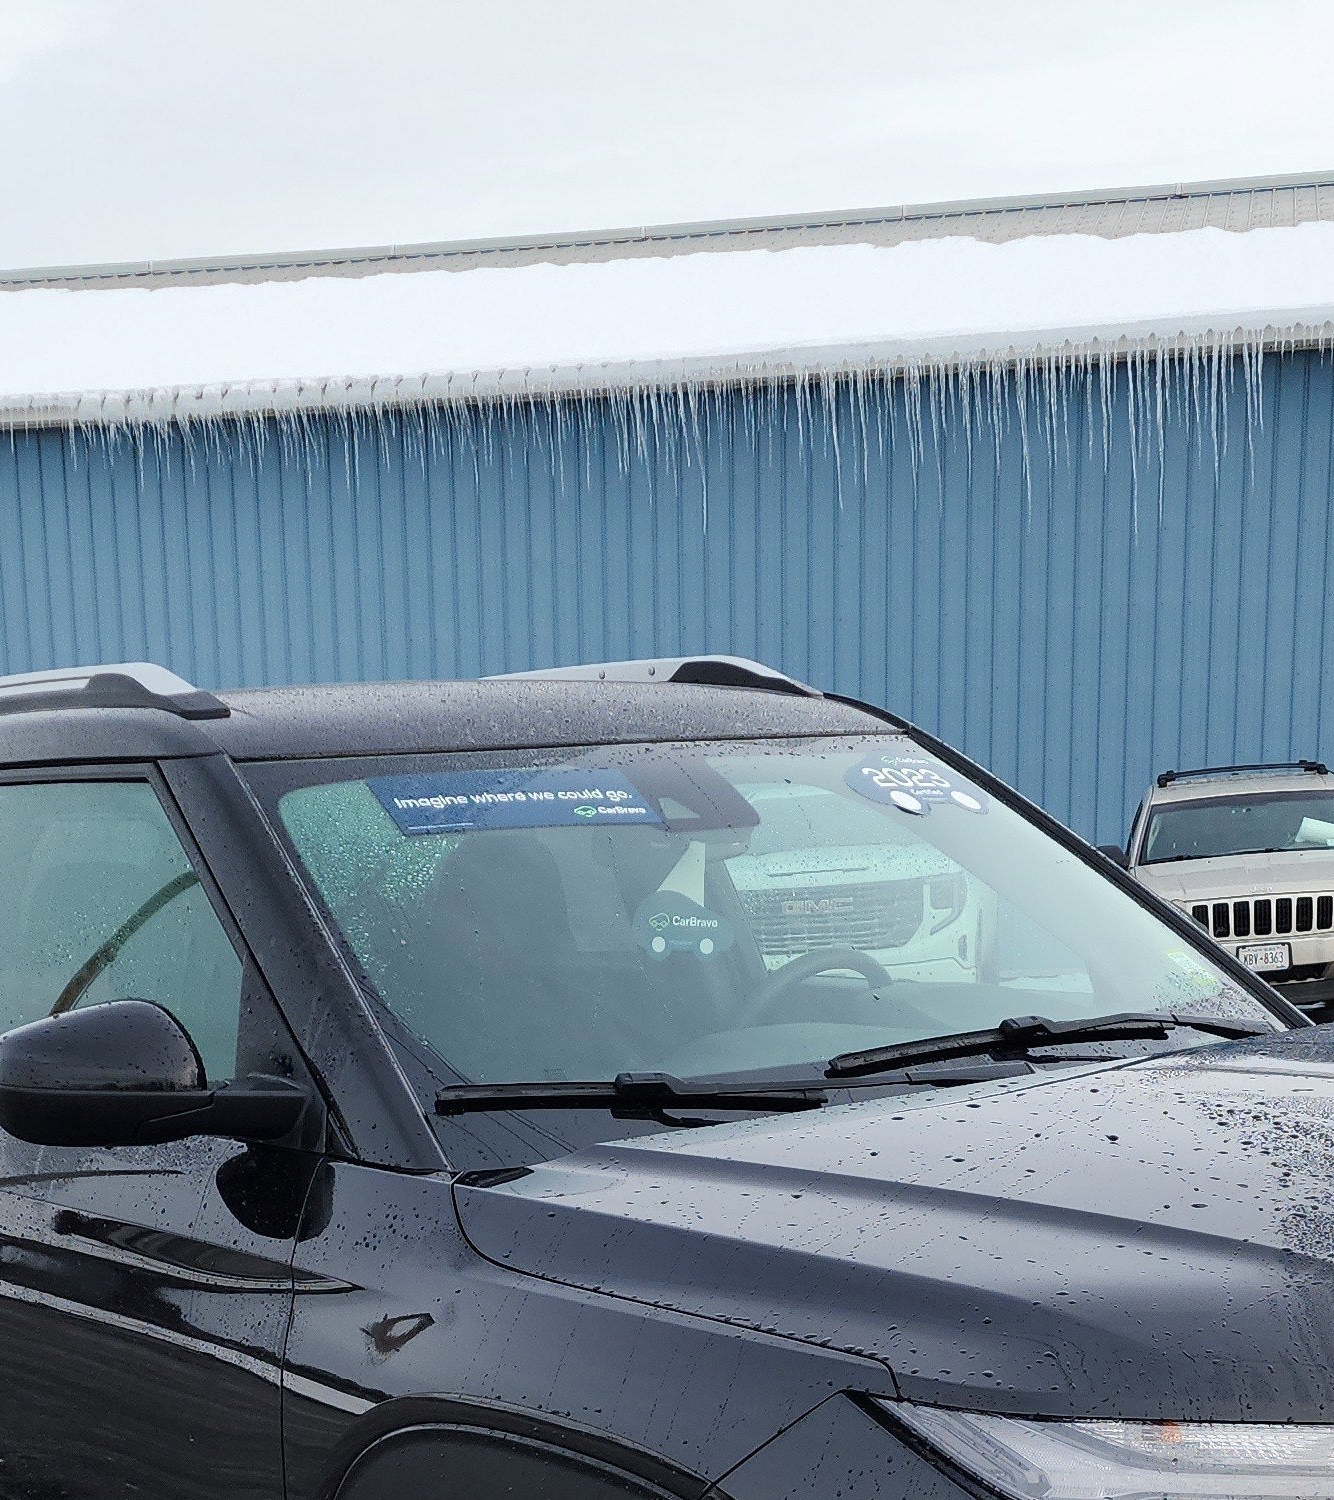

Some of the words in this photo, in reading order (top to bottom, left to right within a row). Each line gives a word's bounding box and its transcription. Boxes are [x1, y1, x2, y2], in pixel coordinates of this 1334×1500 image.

[862, 767, 951, 788] 2023
[393, 794, 469, 810] Imagine
[470, 790, 526, 804] where
[527, 790, 554, 801] we
[557, 788, 604, 800] could
[605, 789, 633, 802] go.
[672, 915, 718, 928] CarBravo
